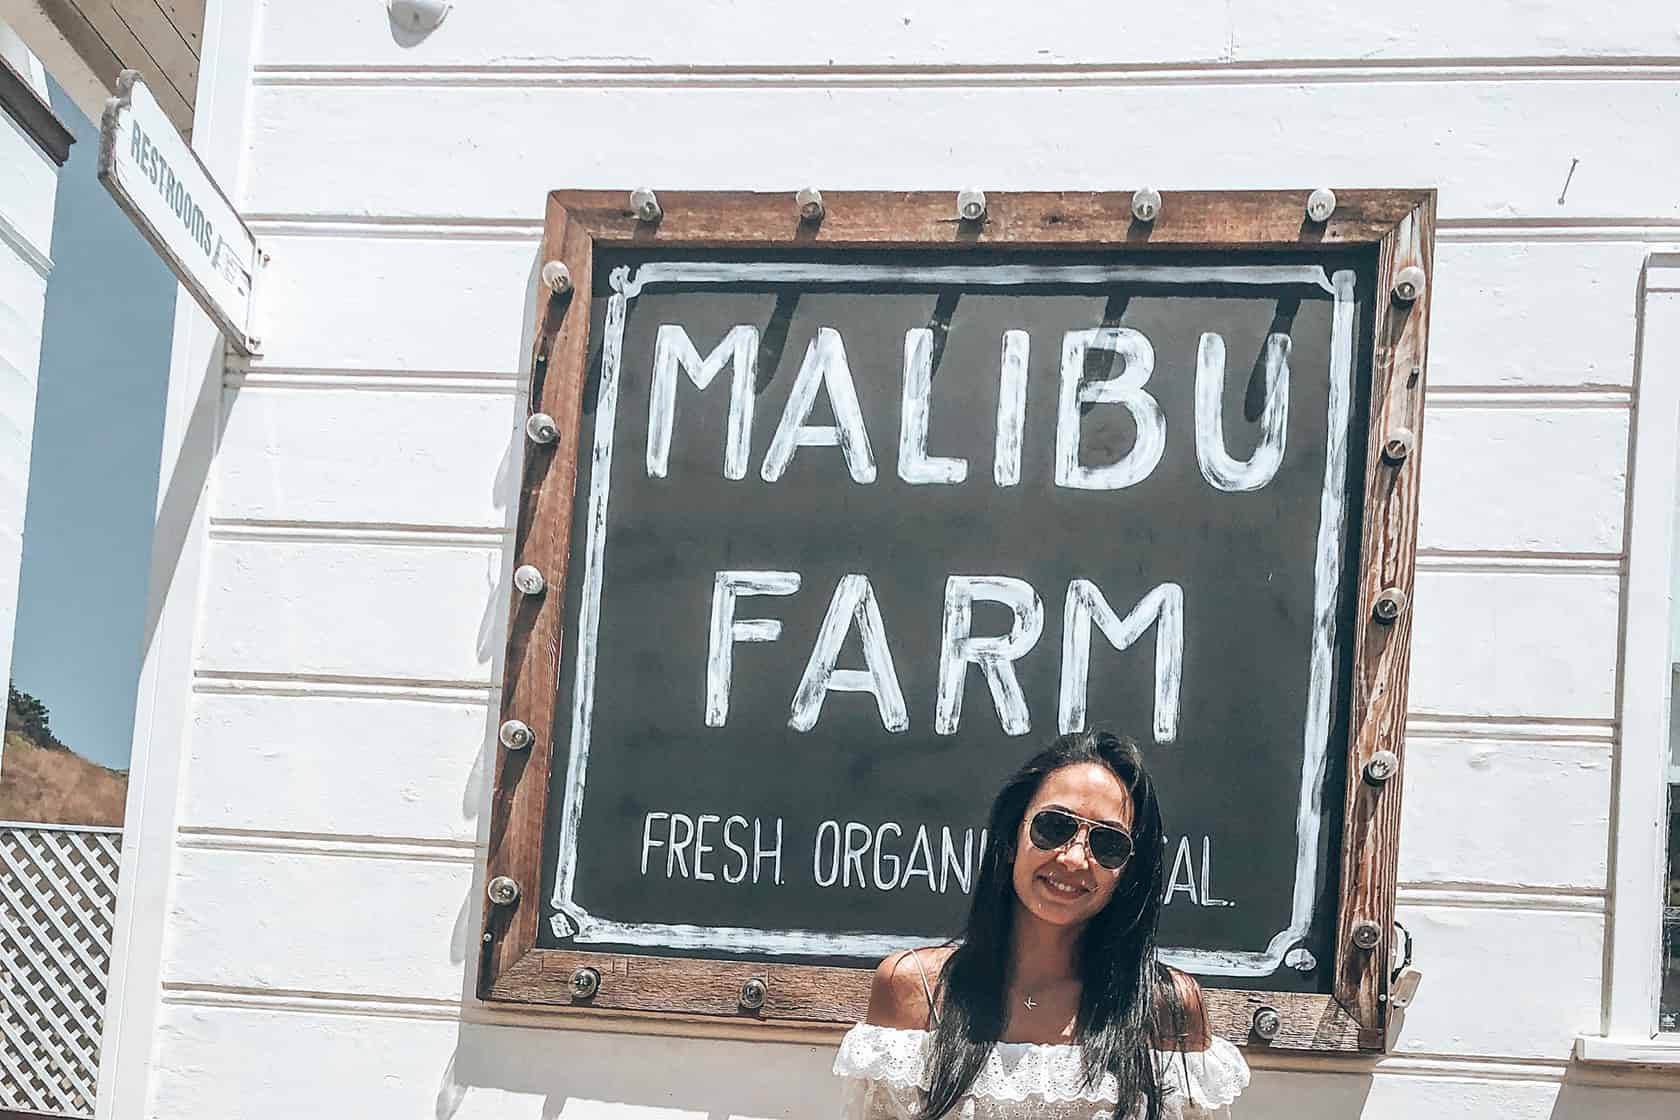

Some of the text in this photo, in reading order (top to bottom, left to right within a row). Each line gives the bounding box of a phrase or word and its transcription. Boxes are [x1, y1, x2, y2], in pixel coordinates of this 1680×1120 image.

[130, 118, 213, 258] RESTROOMS
[645, 324, 1293, 492] MALIBU
[704, 569, 1185, 744] FARM
[641, 812, 785, 886] FRESH.
[813, 819, 988, 895] ORGANI
